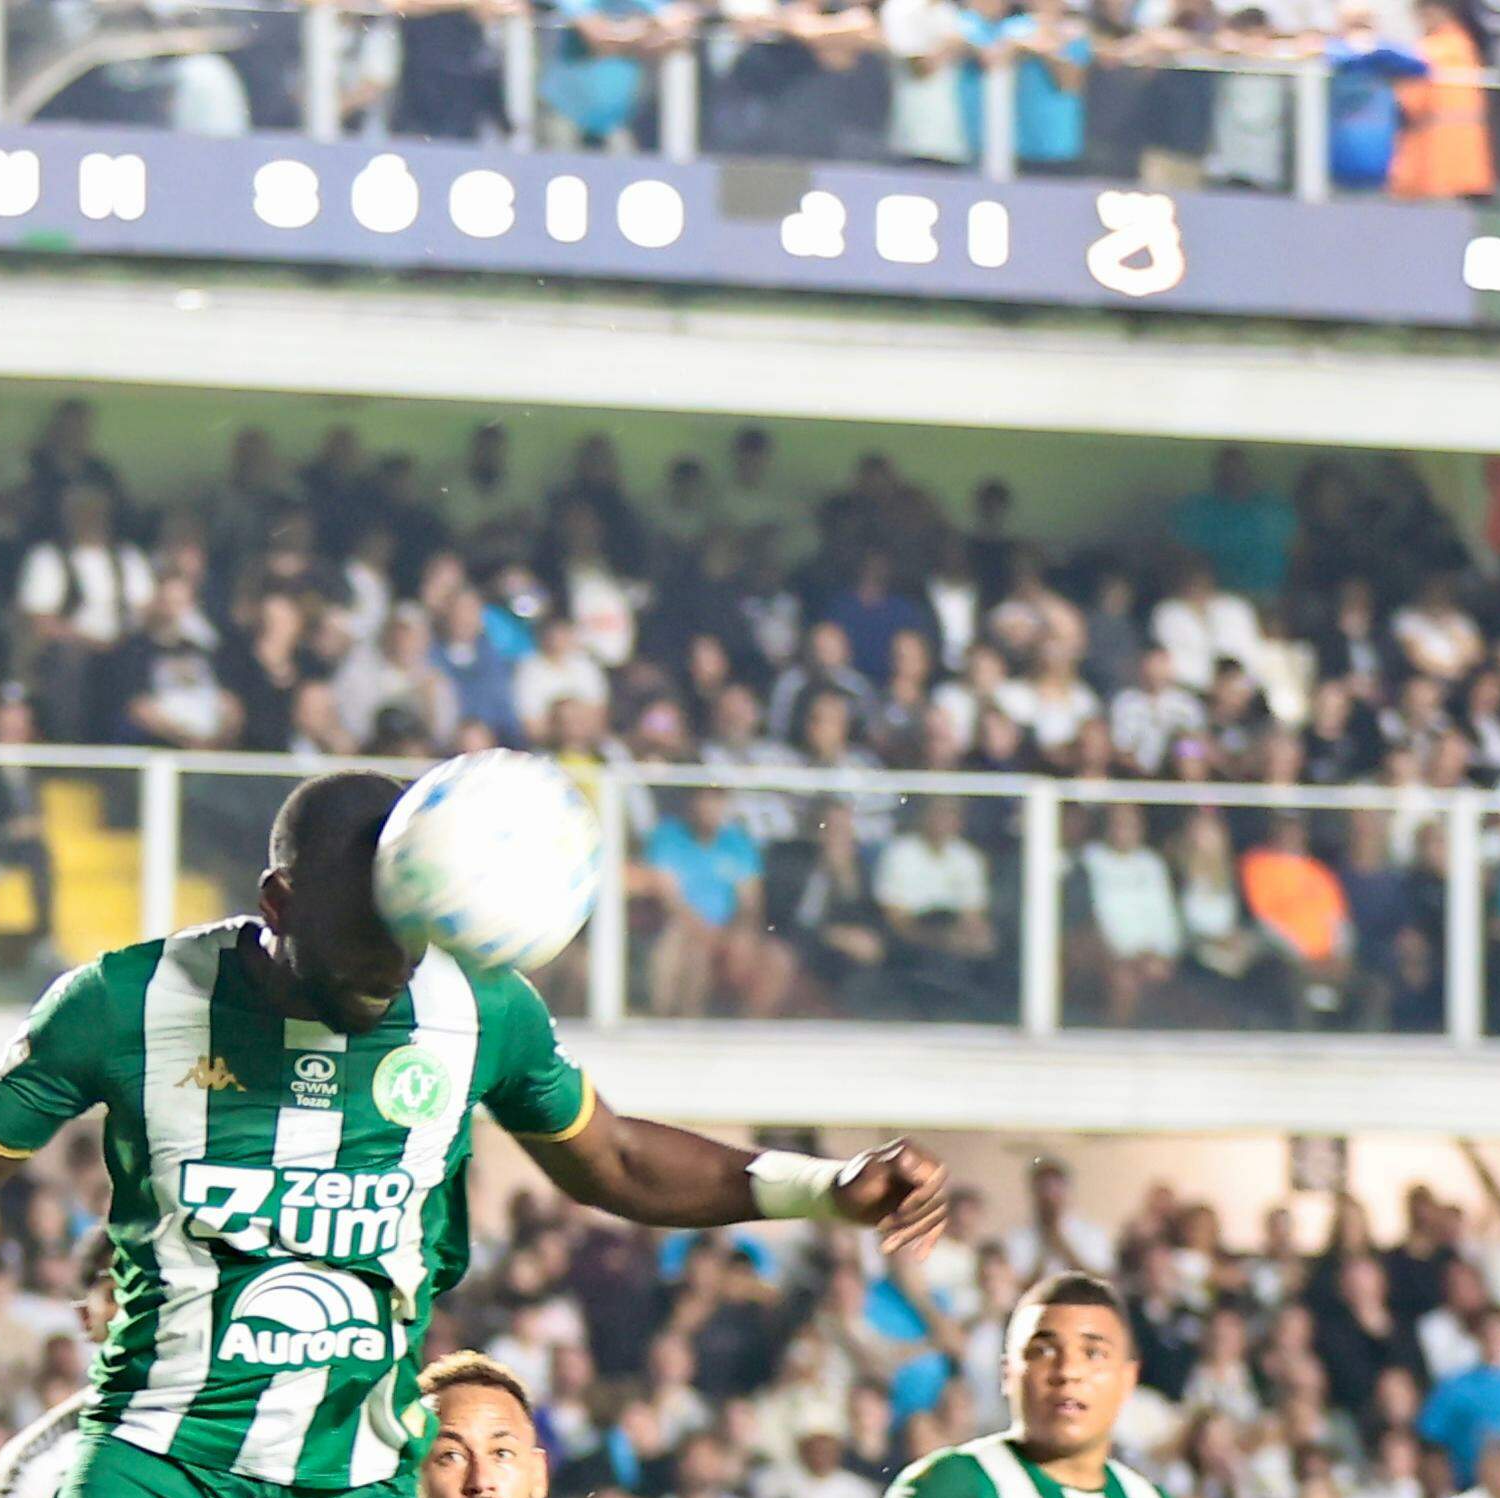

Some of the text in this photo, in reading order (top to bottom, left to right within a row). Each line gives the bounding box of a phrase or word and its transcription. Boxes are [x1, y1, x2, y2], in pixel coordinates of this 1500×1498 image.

[290, 1081, 338, 1095] GWM
[282, 1167, 413, 1210] zero
[278, 1204, 400, 1260] um
[217, 1322, 387, 1365] Aurora
